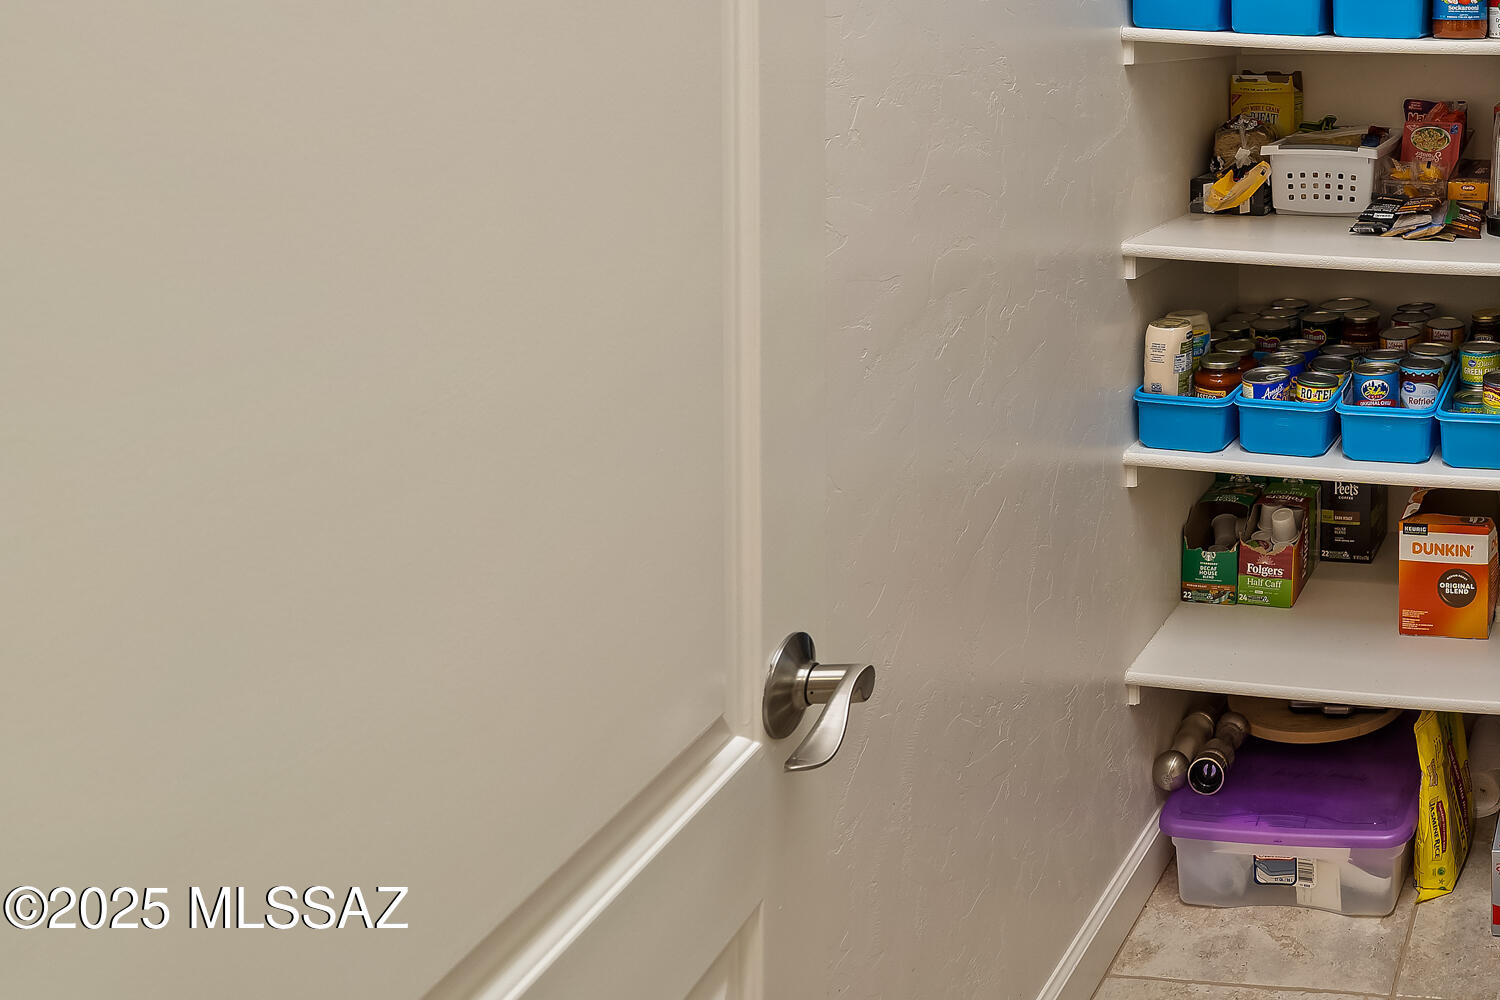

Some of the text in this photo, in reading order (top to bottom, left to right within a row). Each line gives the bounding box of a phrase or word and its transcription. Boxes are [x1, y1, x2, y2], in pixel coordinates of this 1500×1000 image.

[1464, 367, 1483, 375] GREEN
[1262, 383, 1284, 400] Amy's
[1408, 396, 1436, 405] Refried
[1334, 480, 1359, 496] Peet's
[1404, 525, 1427, 533] KEURIG
[1411, 541, 1475, 558] DUNKIN'
[1246, 562, 1284, 577] Folgers
[1247, 577, 1283, 589] Half Caff
[1439, 582, 1475, 590] ORIGINAL
[1239, 593, 1247, 601] 24
[1429, 802, 1440, 840] JASMINE
